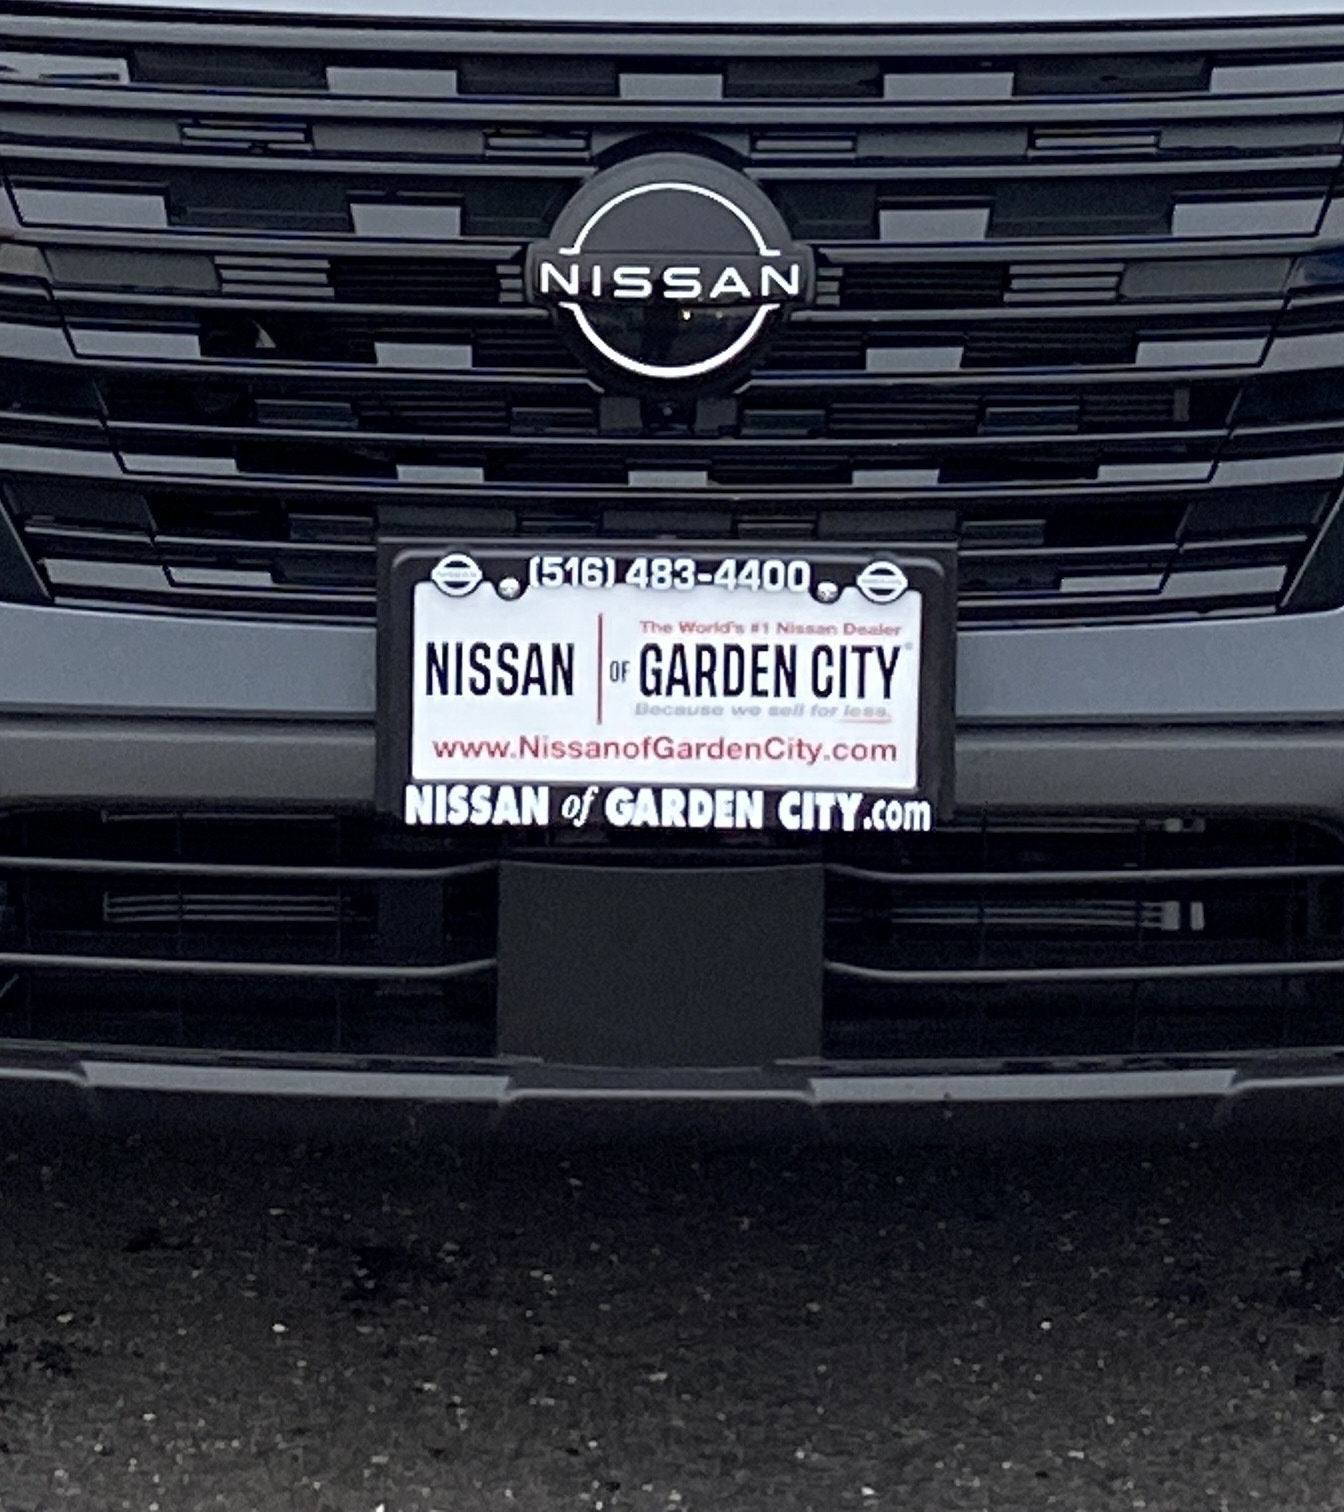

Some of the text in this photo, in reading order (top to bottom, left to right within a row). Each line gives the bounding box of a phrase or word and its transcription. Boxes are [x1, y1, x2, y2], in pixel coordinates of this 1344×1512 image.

[540, 262, 800, 299] NISSAN
[529, 556, 810, 592] (516) 483-4400
[639, 620, 903, 637] The World's #1 Nissan Dealer
[425, 641, 901, 700] NISSAN OF GARDEN CITY
[635, 701, 724, 717] Because
[731, 704, 762, 717] we
[768, 702, 805, 718] sell
[810, 702, 839, 718] for
[432, 733, 898, 766] www.NissanofGardenCity.com
[405, 784, 933, 832] NISSAN of GARDEN CITY.com
